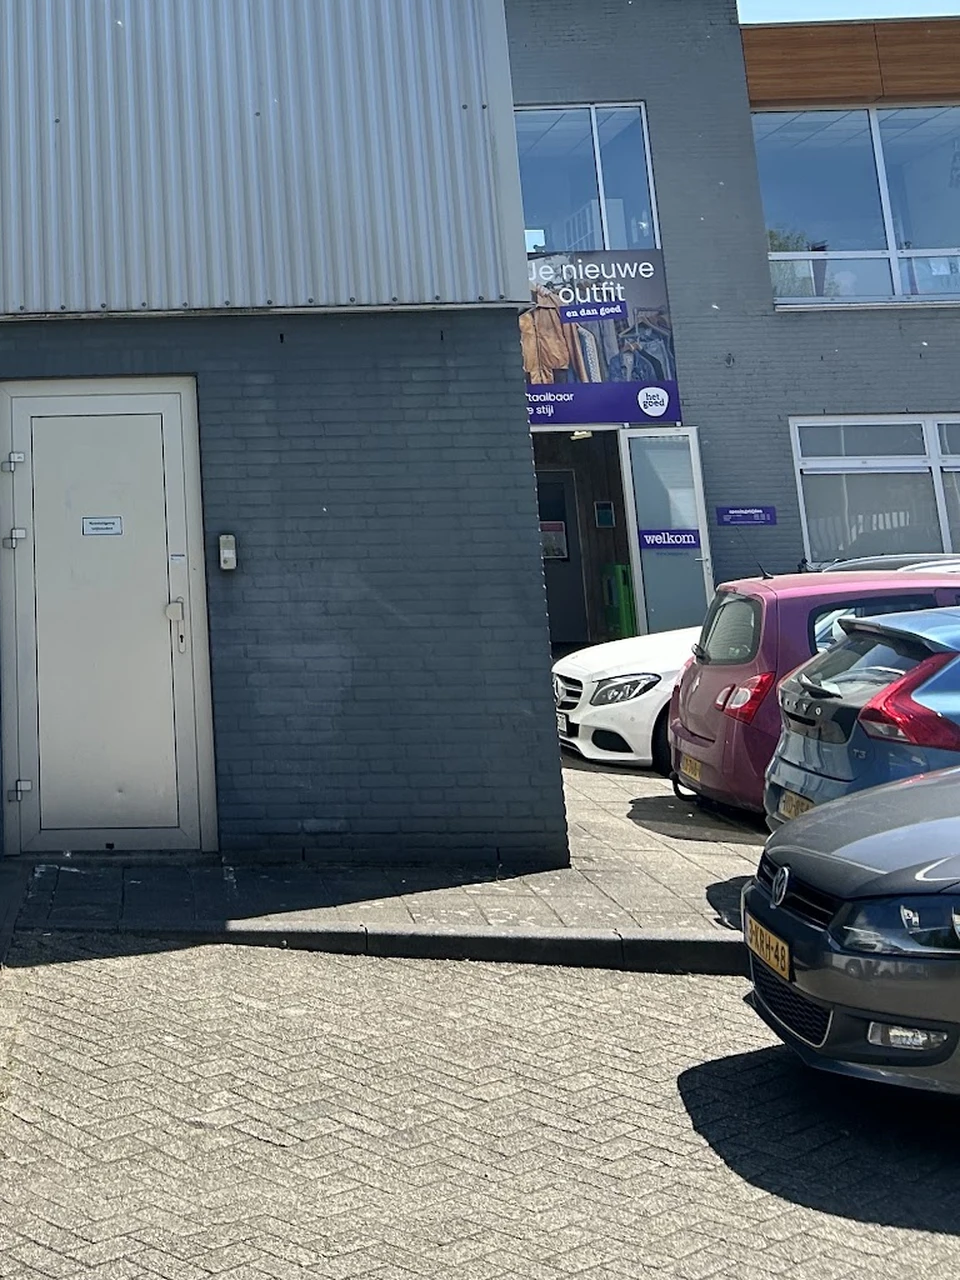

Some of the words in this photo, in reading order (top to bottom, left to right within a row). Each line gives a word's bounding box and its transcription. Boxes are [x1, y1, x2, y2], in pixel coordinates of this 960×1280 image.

[528, 262, 554, 281] Je
[562, 258, 655, 279] nieuwe
[559, 281, 626, 303] outfit
[566, 310, 579, 318] en
[580, 307, 598, 317] dan
[600, 305, 622, 317] goed
[645, 392, 660, 401] het
[642, 398, 665, 409] goed
[536, 404, 554, 417] stijl
[643, 532, 696, 545] welkom
[853, 748, 867, 759] T3
